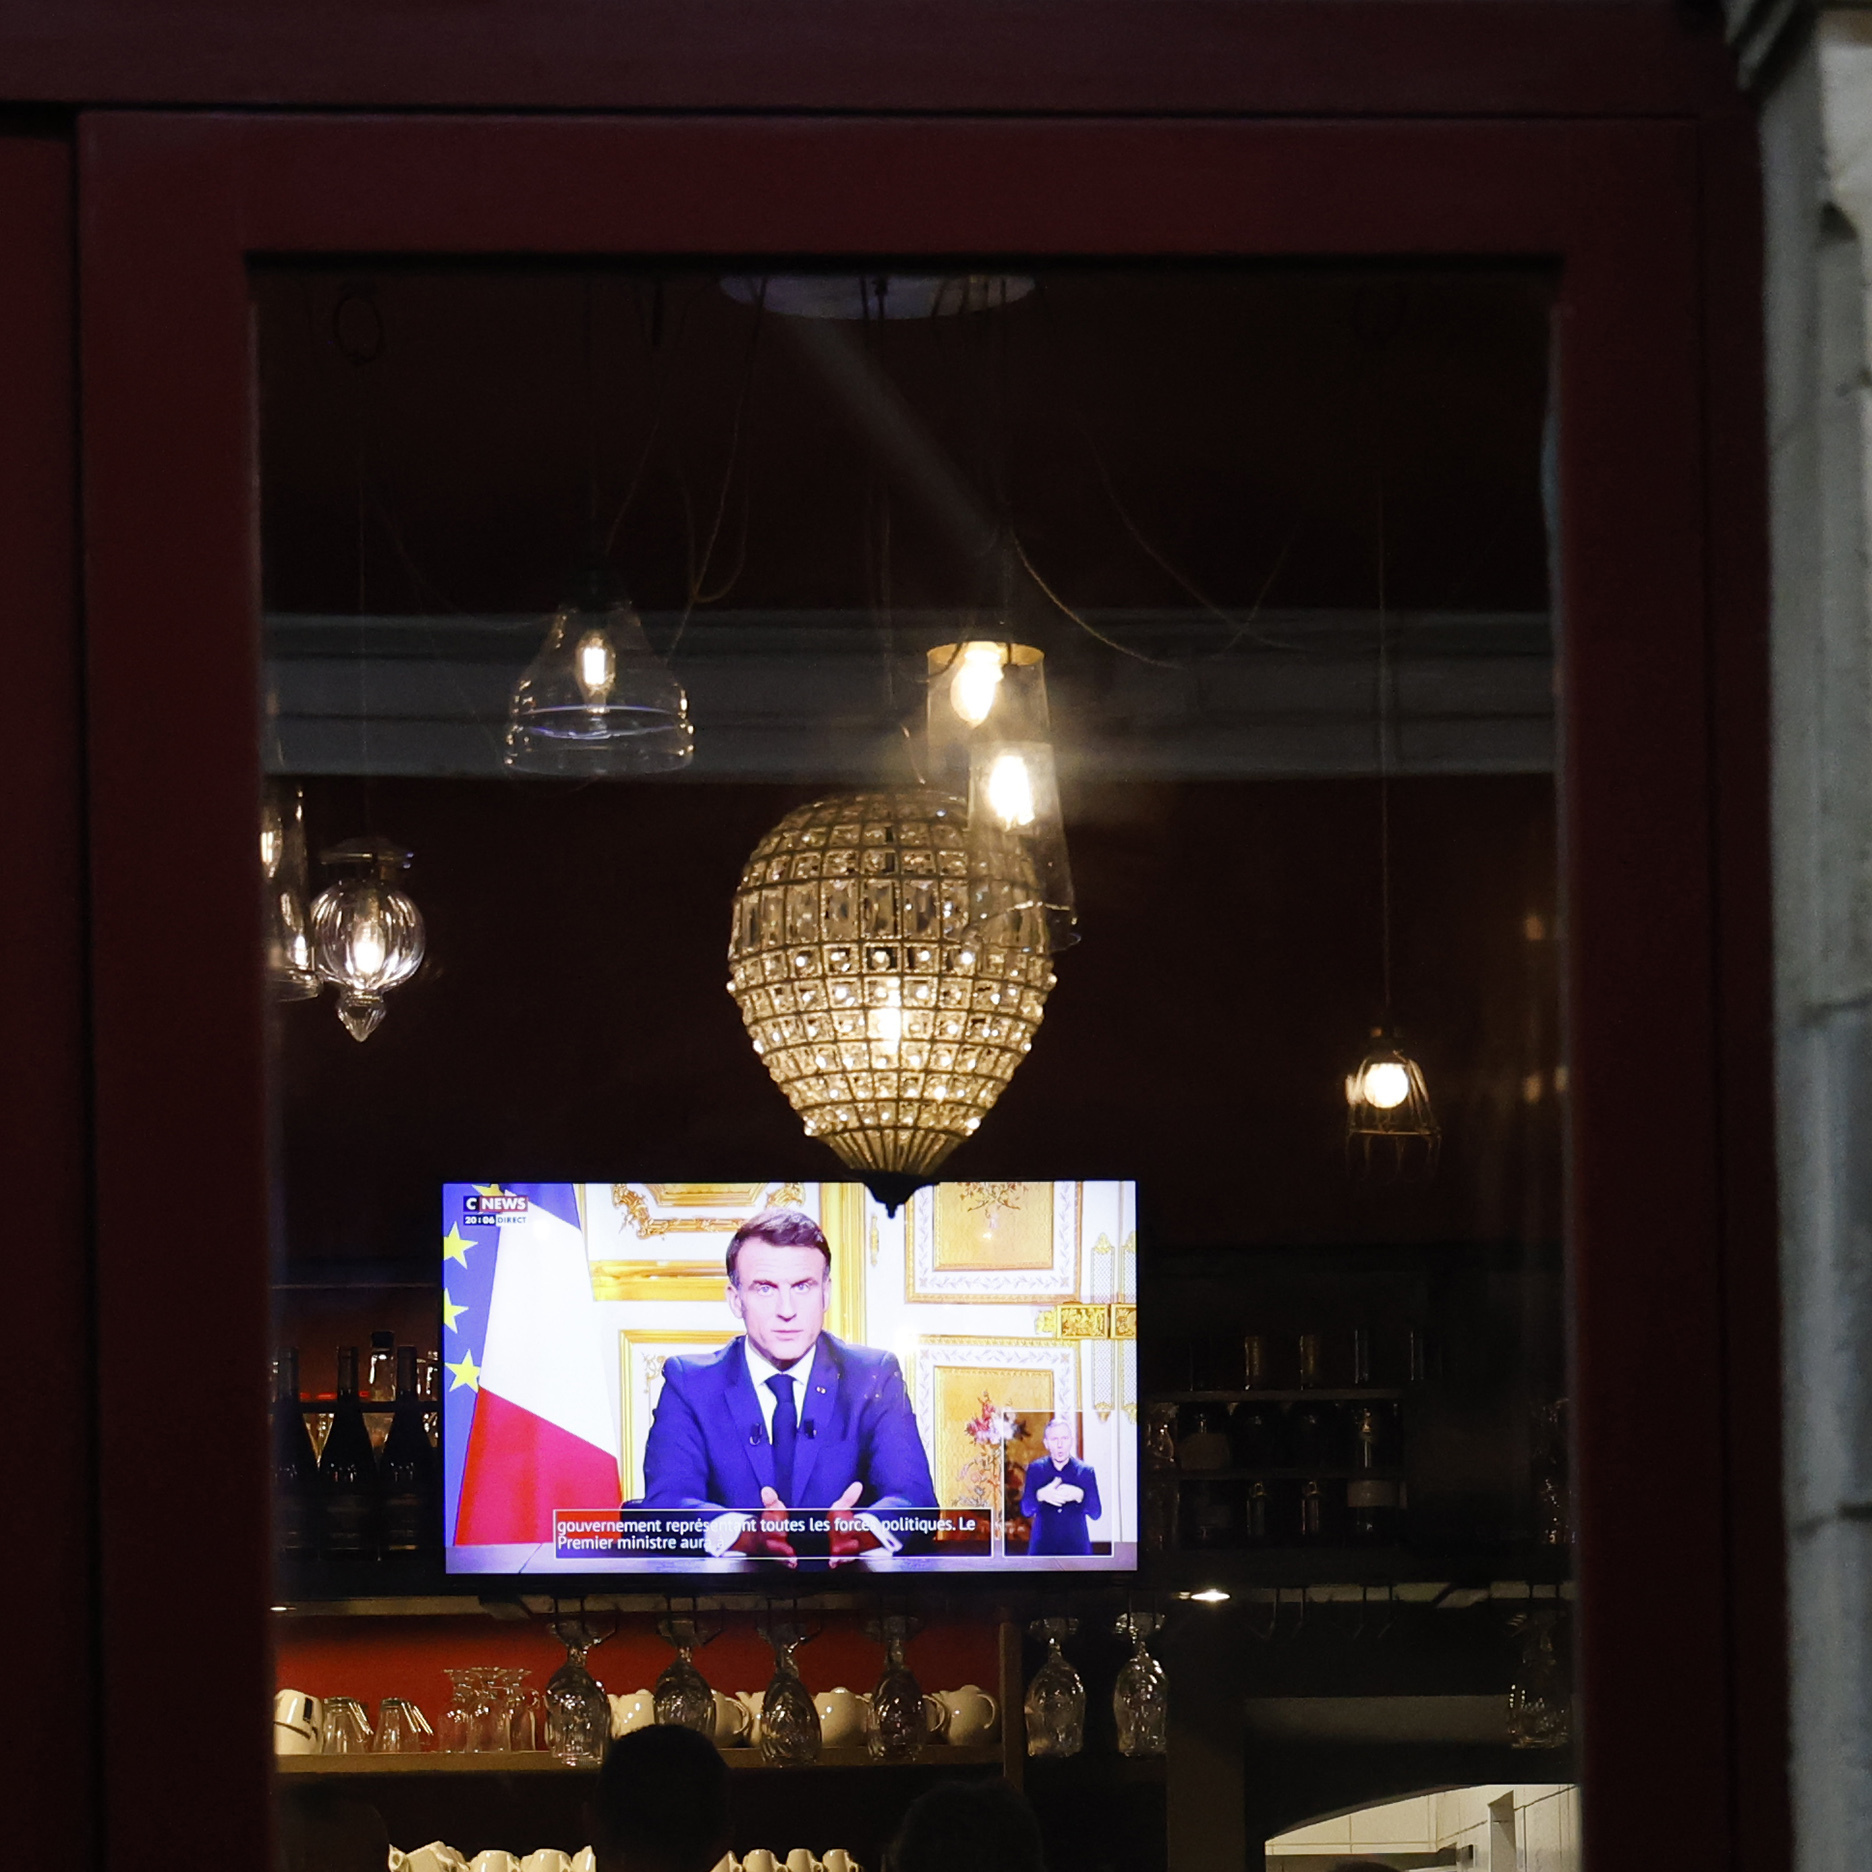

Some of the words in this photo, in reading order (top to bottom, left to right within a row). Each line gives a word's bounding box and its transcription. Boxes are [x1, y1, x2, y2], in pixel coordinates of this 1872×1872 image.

[481, 1197, 526, 1210] NEWS
[465, 1216, 495, 1225] 20:06
[497, 1216, 527, 1224] DIRECT
[557, 1518, 662, 1535] gouvernement
[665, 1517, 757, 1535] représentant
[760, 1517, 805, 1531] toutes
[809, 1516, 831, 1531] les
[834, 1516, 877, 1531] forces
[882, 1516, 956, 1534] politiques.
[959, 1516, 976, 1531] Le
[558, 1535, 613, 1550] Premier
[617, 1534, 676, 1550] ministre
[680, 1537, 713, 1550] aura
